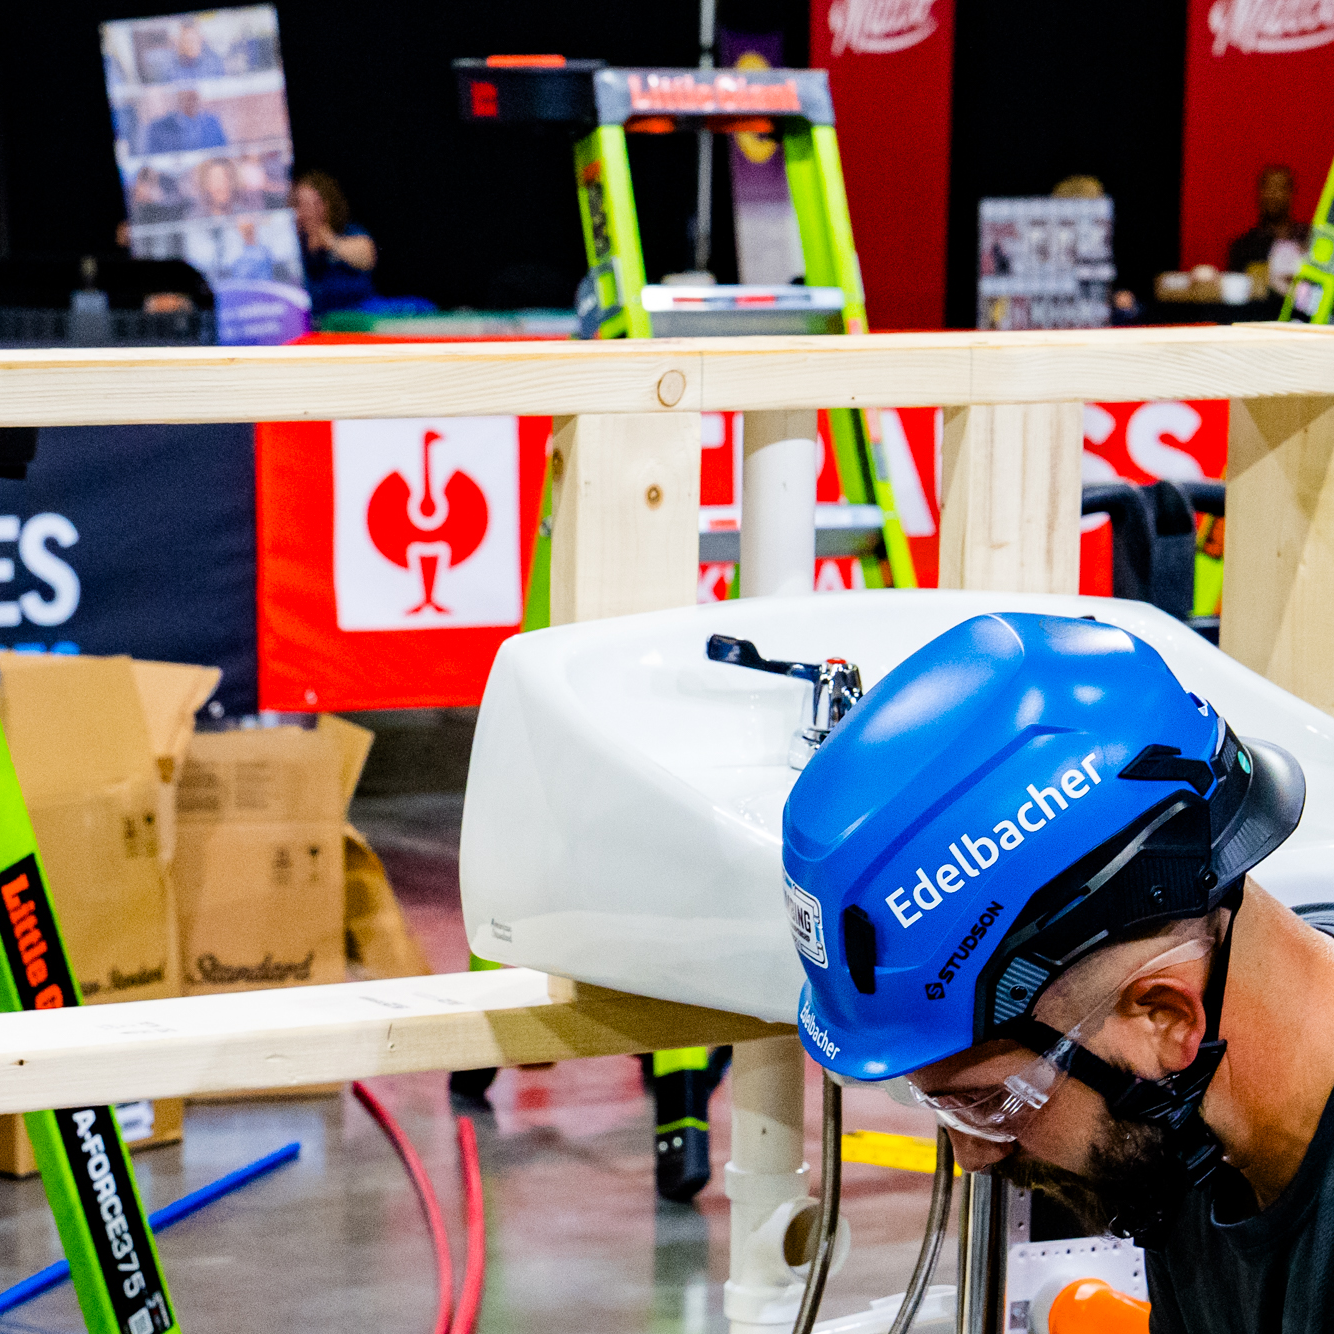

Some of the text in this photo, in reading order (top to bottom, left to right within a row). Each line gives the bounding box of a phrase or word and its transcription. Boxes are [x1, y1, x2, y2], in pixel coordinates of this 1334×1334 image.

[884, 752, 1105, 929] Edelbacher
[1, 872, 51, 988] Little
[939, 900, 1006, 984] STUDSON
[799, 1000, 841, 1061] Edelbacher
